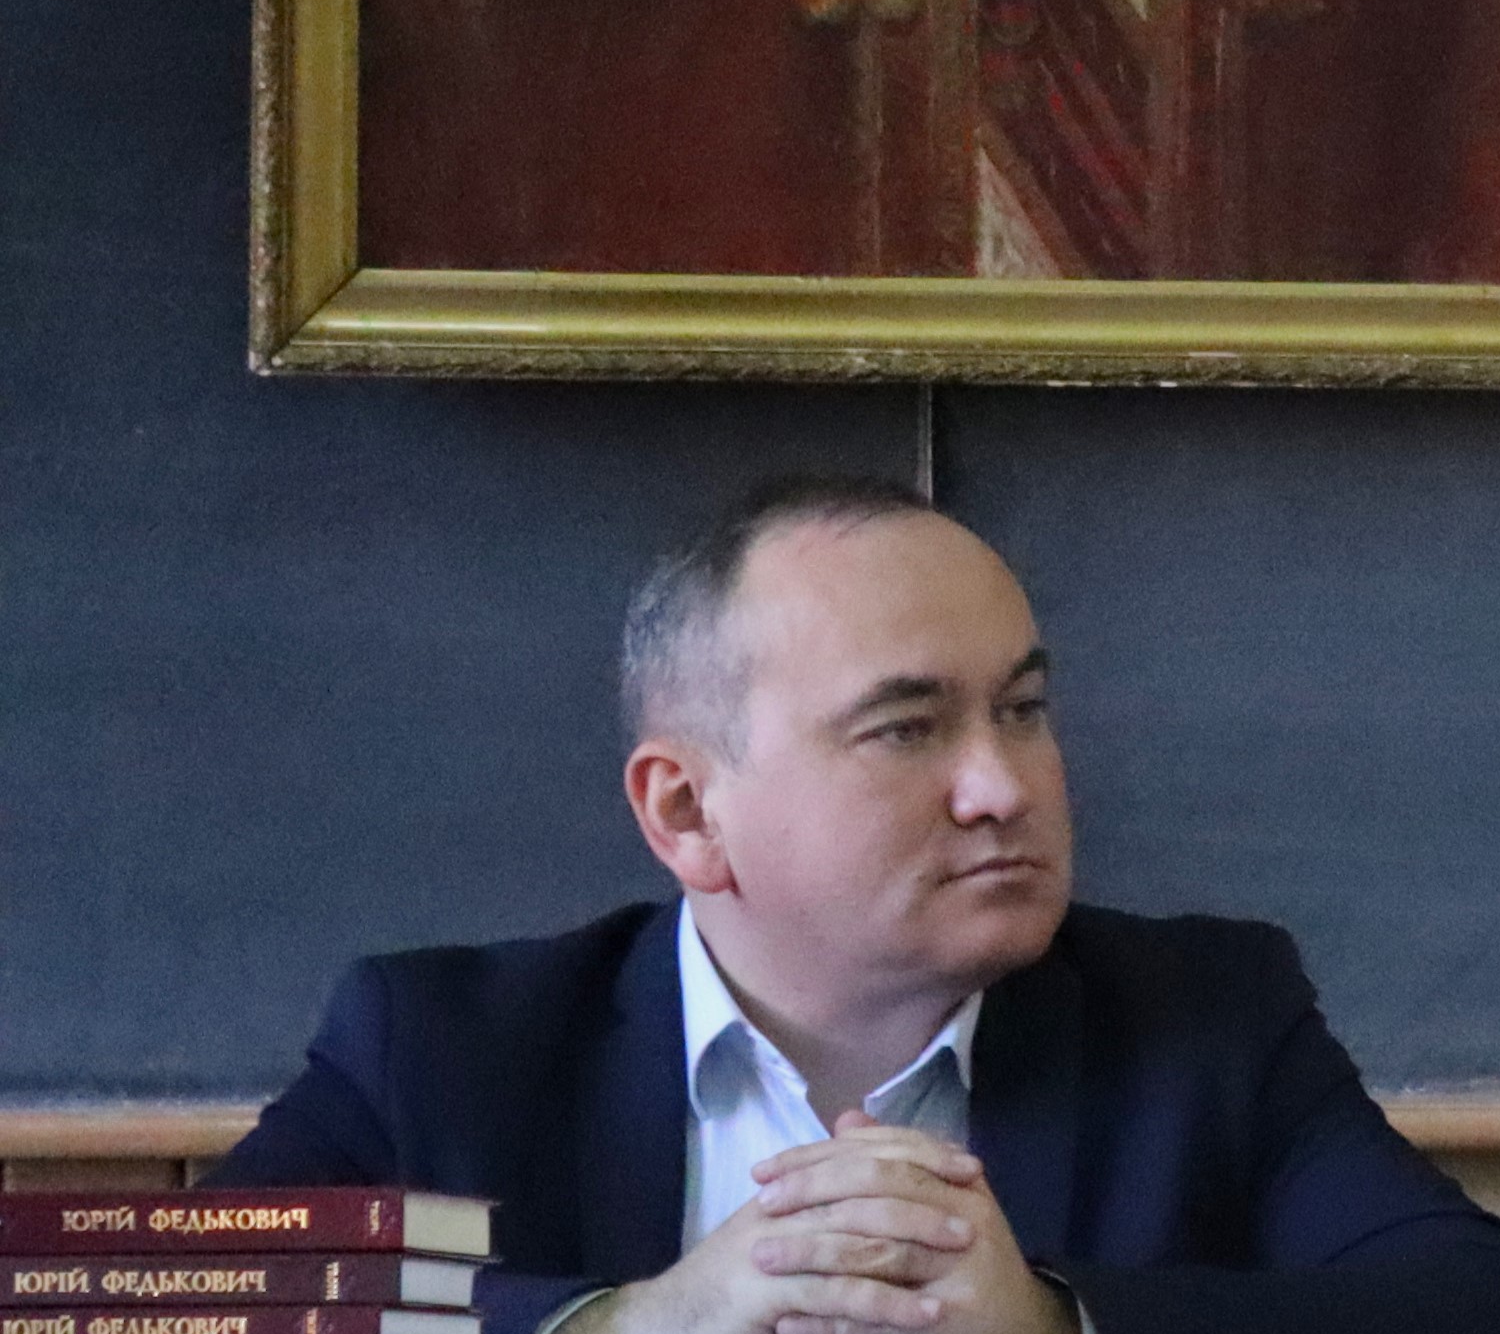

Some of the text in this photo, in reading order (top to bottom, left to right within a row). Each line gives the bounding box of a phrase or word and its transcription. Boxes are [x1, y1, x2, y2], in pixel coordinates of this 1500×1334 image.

[61, 1206, 310, 1235] ЮРІЙ ФЕДЬКОВИЧ
[13, 1266, 267, 1298] ЮРІЙ ФЕДЬКОВИЧ
